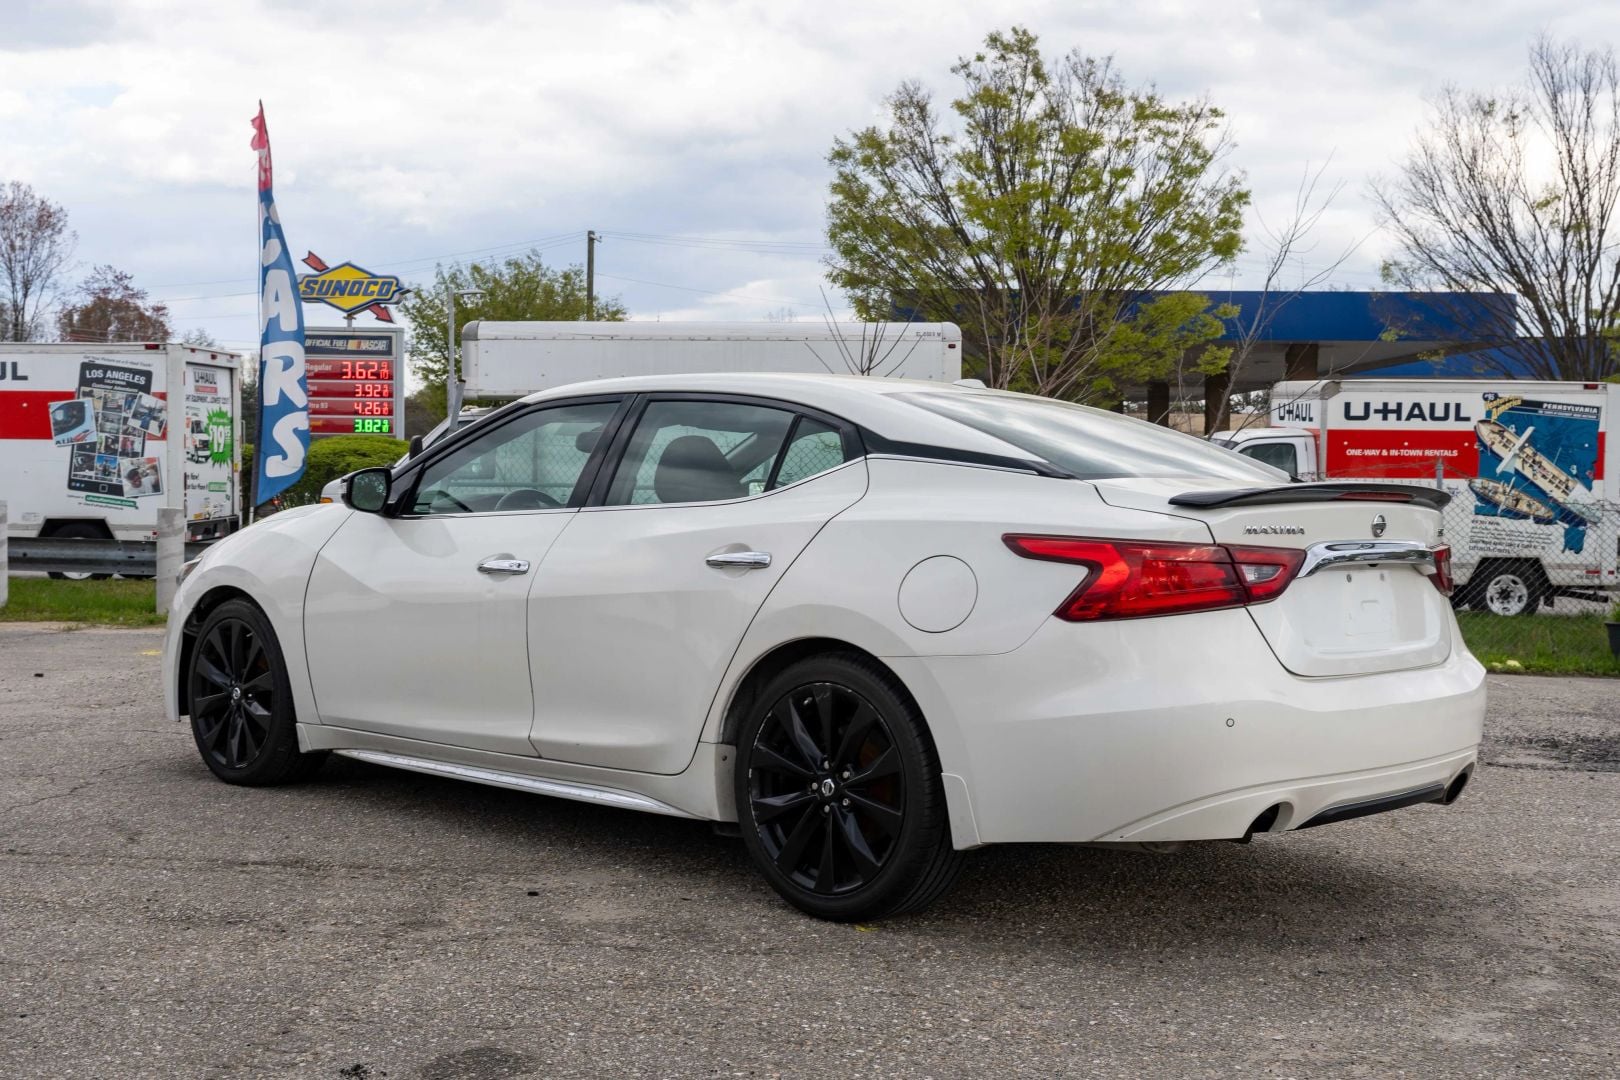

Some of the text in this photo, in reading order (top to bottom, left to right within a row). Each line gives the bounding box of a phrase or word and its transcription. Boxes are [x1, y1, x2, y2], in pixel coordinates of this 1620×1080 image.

[301, 279, 394, 297] SUNOCO
[305, 339, 346, 347] OFFICIAL FUEL
[359, 340, 387, 351] NASCAR
[86, 369, 146, 384] LOS ANGELES
[305, 363, 332, 372] Regular
[342, 362, 378, 379] 3.62
[193, 371, 216, 384] U-HAUL
[355, 384, 381, 397] 3.92
[354, 402, 380, 414] 4.26
[1278, 402, 1314, 422] U-HAUL
[1344, 402, 1471, 422] U-HAUL
[1542, 403, 1598, 414] PENNSYLVANIA
[354, 419, 381, 432] 3.82
[1244, 525, 1305, 535] MAXIMA
